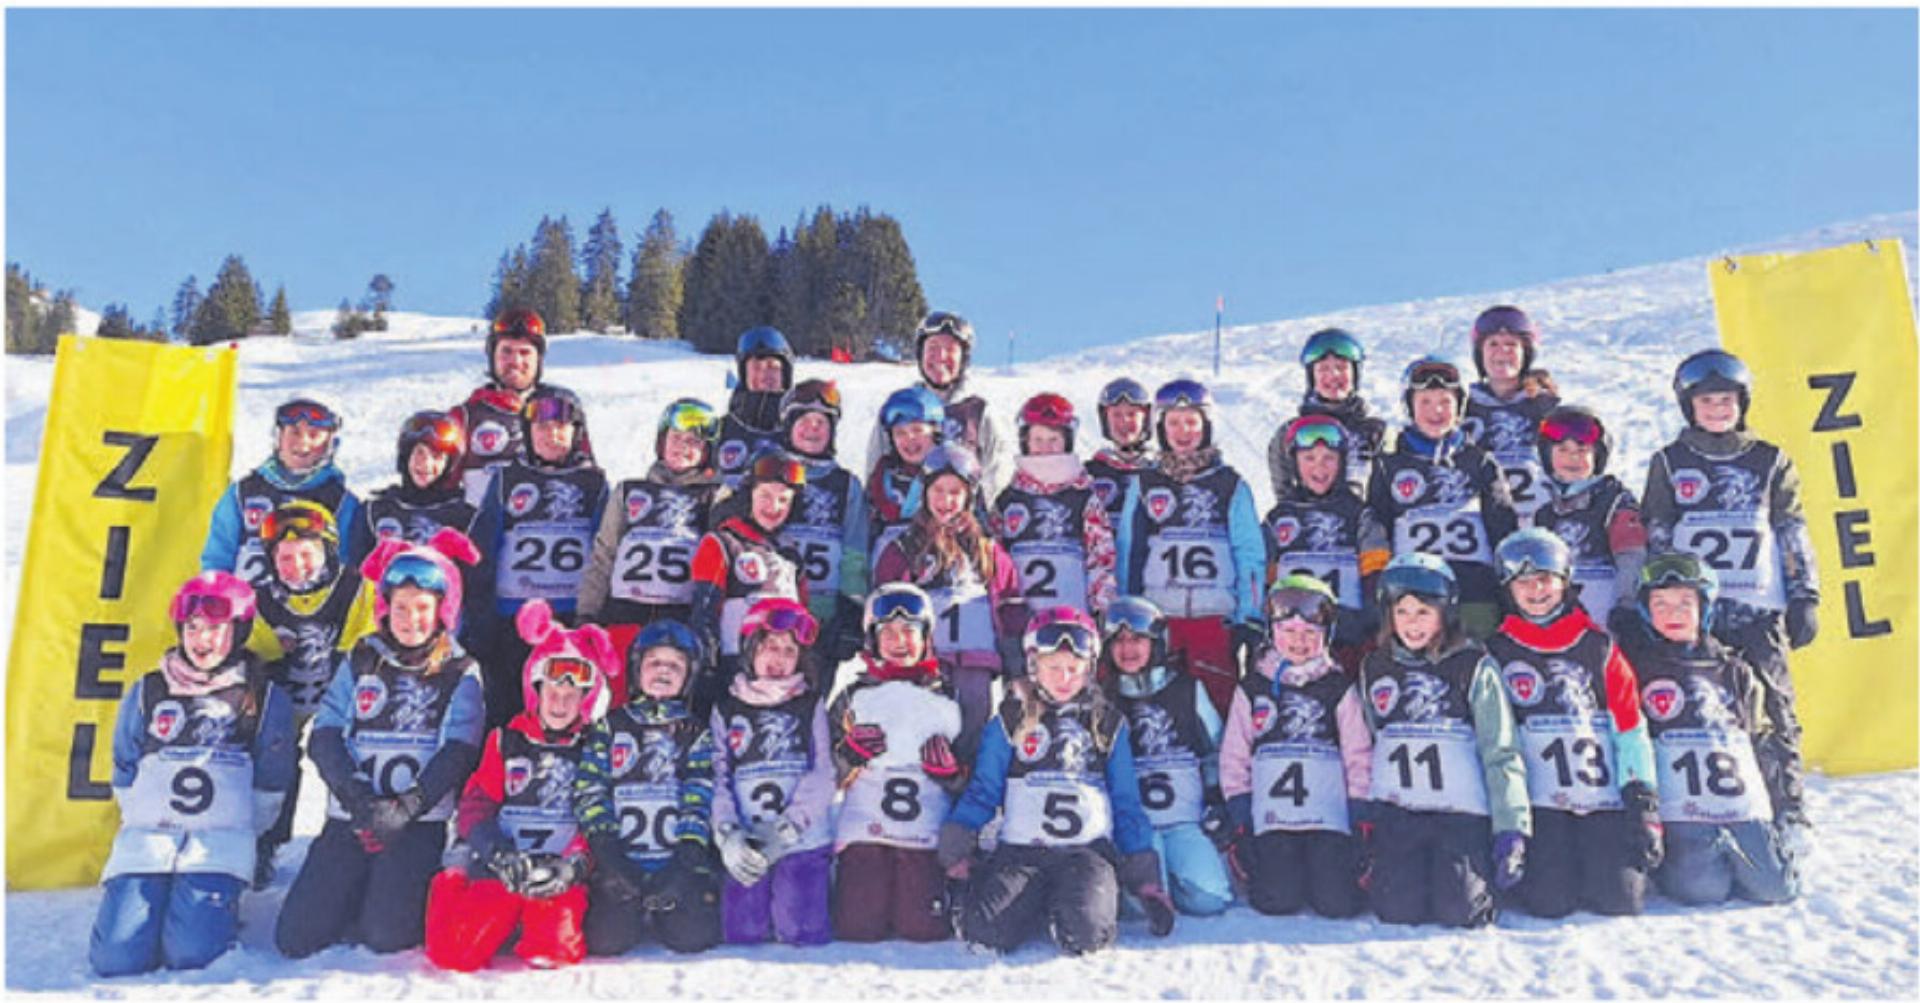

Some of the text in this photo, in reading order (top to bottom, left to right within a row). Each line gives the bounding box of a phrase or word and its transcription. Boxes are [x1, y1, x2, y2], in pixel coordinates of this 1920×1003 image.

[1808, 371, 1892, 640] ZIEL
[511, 536, 584, 572] 26
[1408, 519, 1479, 557] 23
[1690, 528, 1764, 570] 27
[622, 544, 690, 584] 25
[1024, 558, 1058, 599] 2
[1160, 544, 1219, 580] 16
[66, 431, 160, 802] ZIEL
[939, 607, 960, 642] 1
[1268, 760, 1310, 808] 4
[1388, 743, 1443, 791] 11
[1541, 737, 1610, 788] 13
[1671, 749, 1747, 798] 18
[170, 766, 215, 815] 9
[750, 781, 785, 826] 3
[880, 777, 922, 822] 8
[1138, 771, 1177, 812] 6
[619, 806, 682, 850] 20
[1041, 792, 1083, 840] 5
